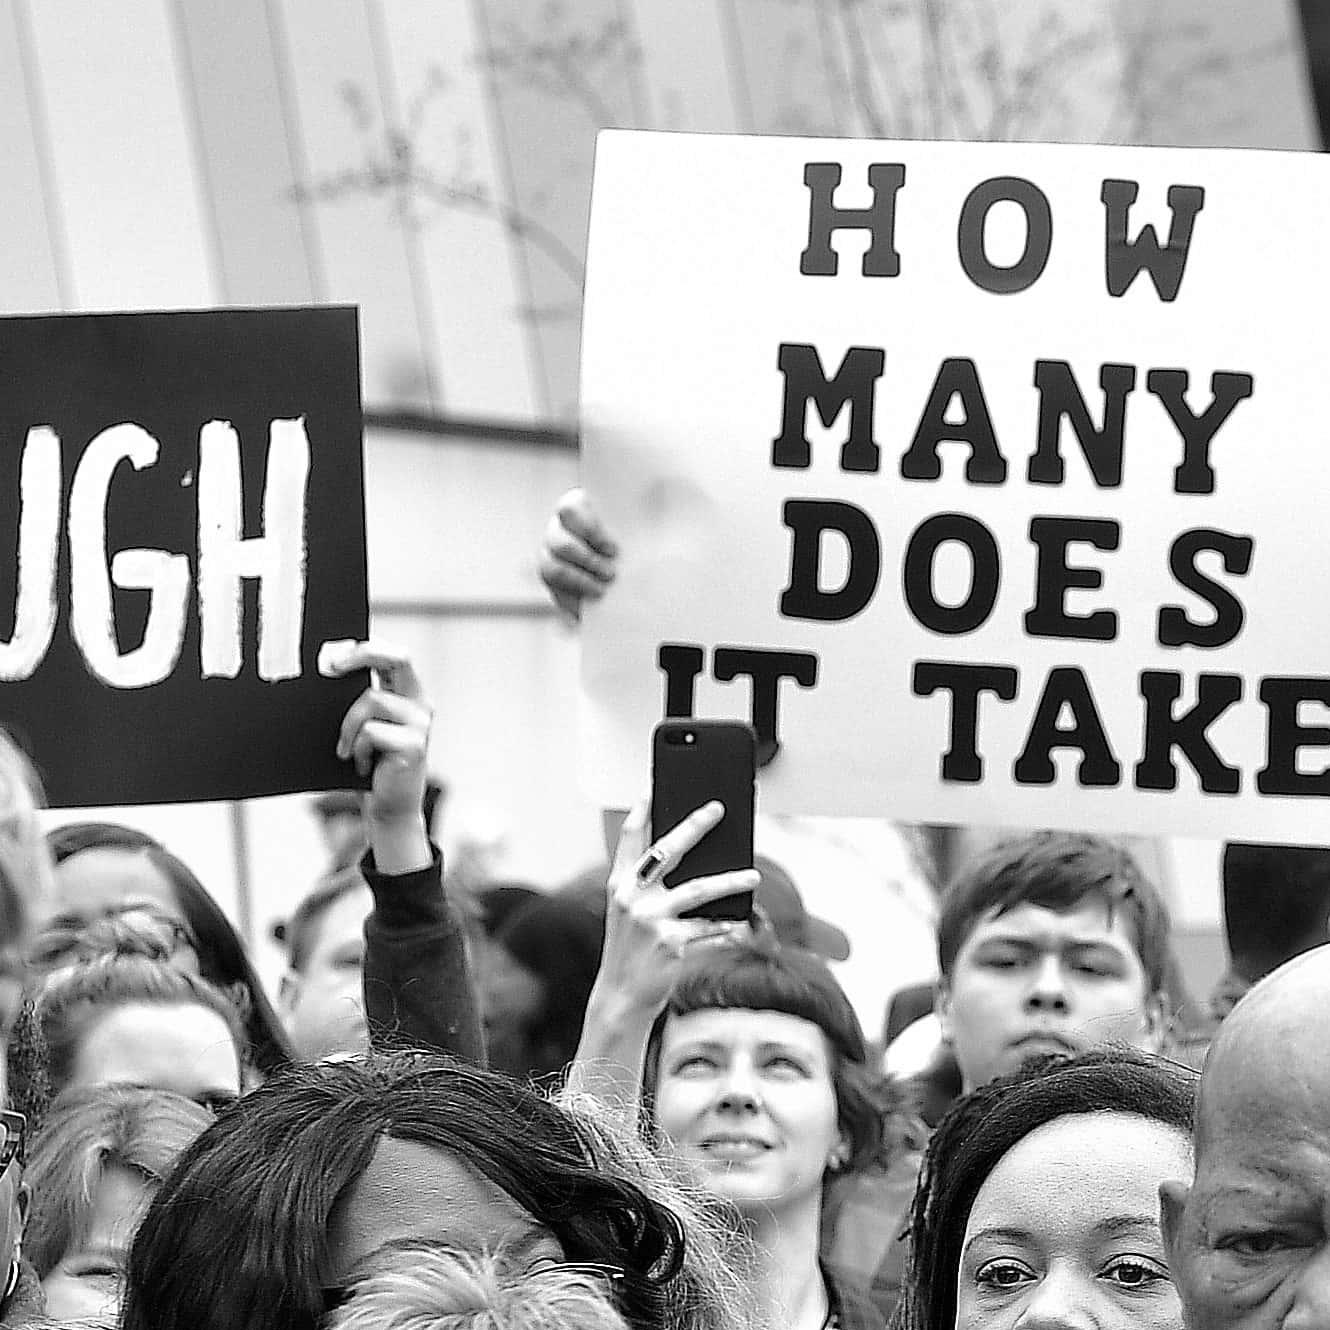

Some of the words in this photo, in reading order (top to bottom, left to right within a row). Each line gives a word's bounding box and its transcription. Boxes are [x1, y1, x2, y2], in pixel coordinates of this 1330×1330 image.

[799, 162, 1206, 303] HOW
[771, 343, 1254, 495] MANY
[780, 499, 1254, 648] DOES
[658, 644, 818, 769] IT
